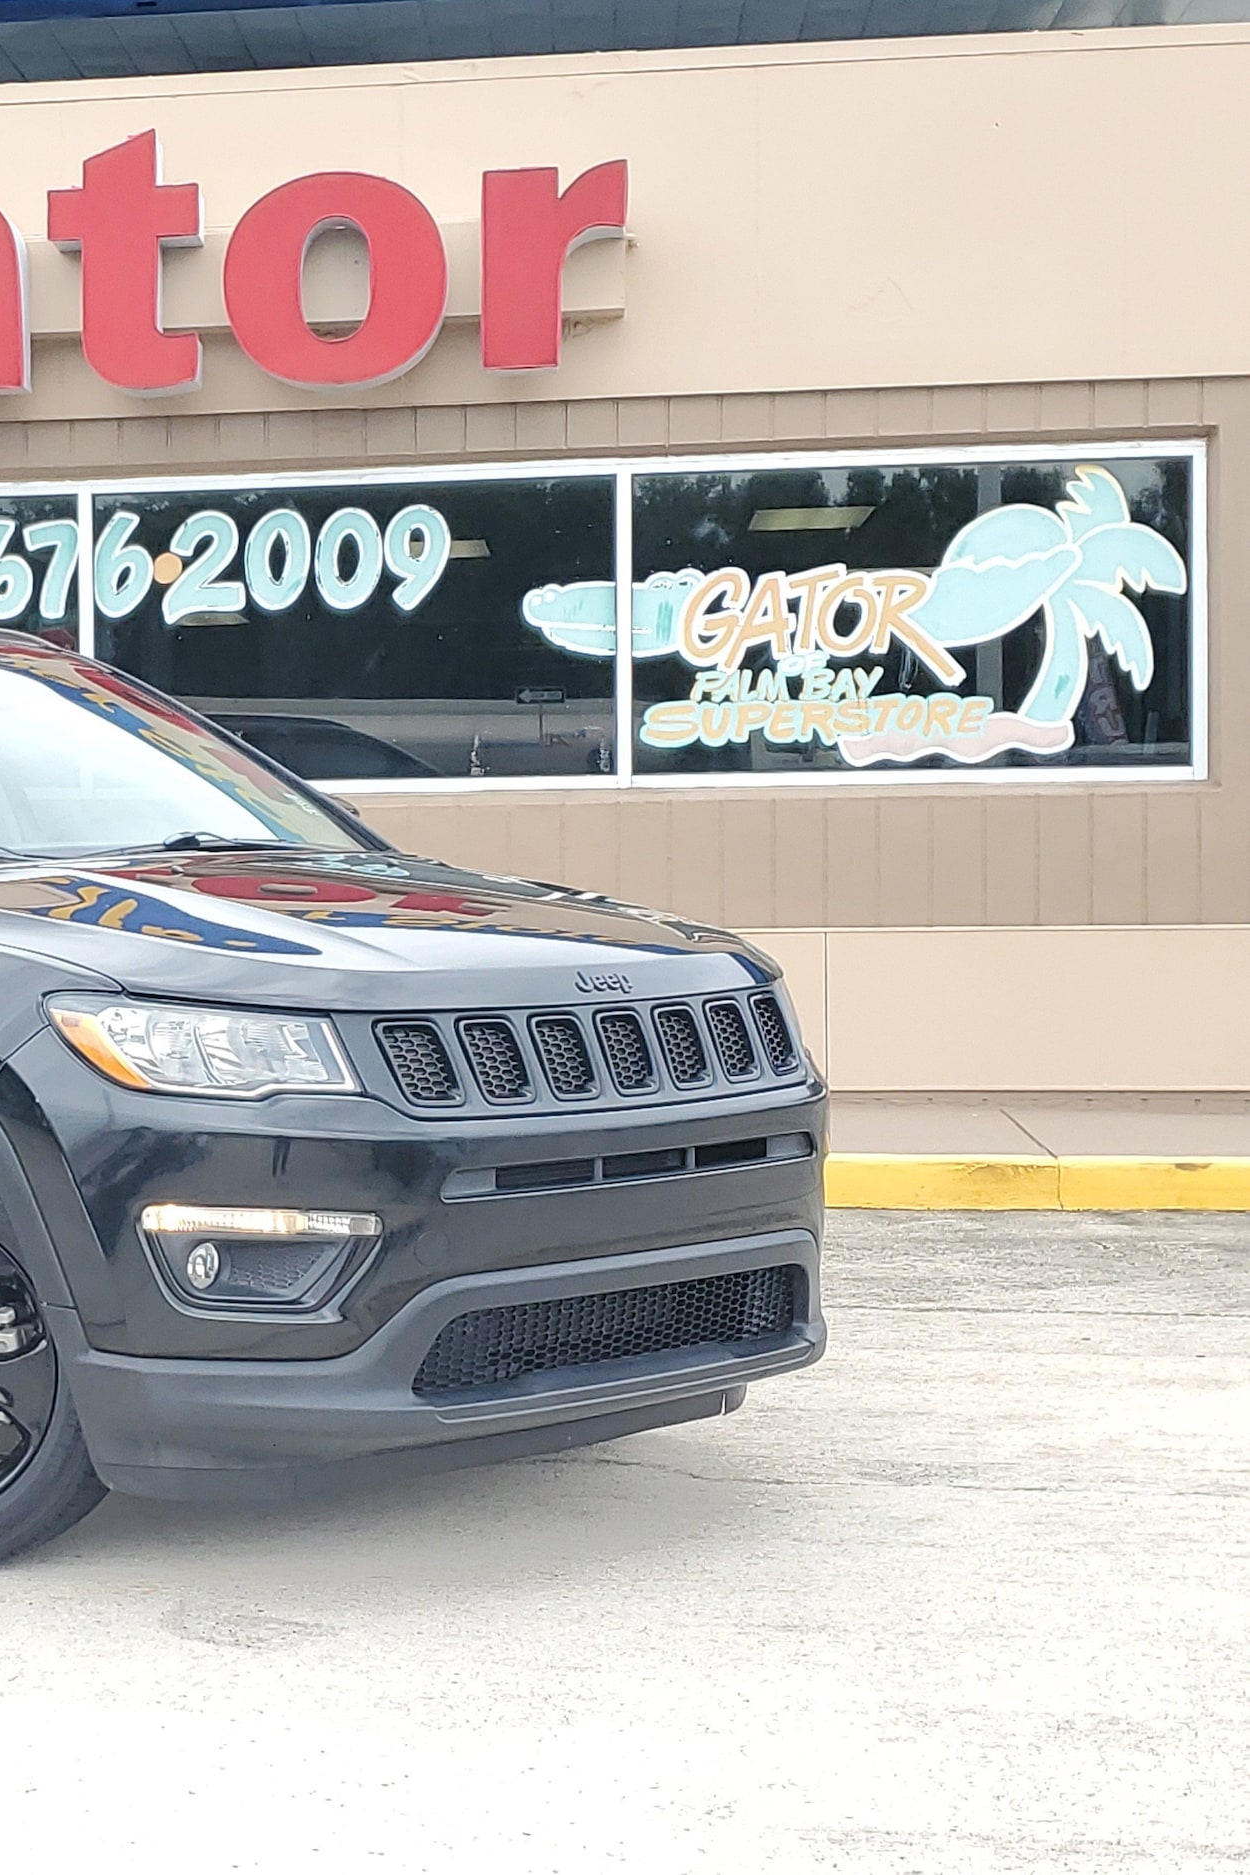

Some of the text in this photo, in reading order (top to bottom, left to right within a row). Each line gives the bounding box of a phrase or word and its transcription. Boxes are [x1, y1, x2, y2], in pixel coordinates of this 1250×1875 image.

[680, 563, 967, 687] GATOR
[778, 650, 831, 678] OF
[690, 665, 884, 703] PALM BAY
[640, 692, 995, 747] SUPERSTORE
[572, 968, 634, 996] Jeep
